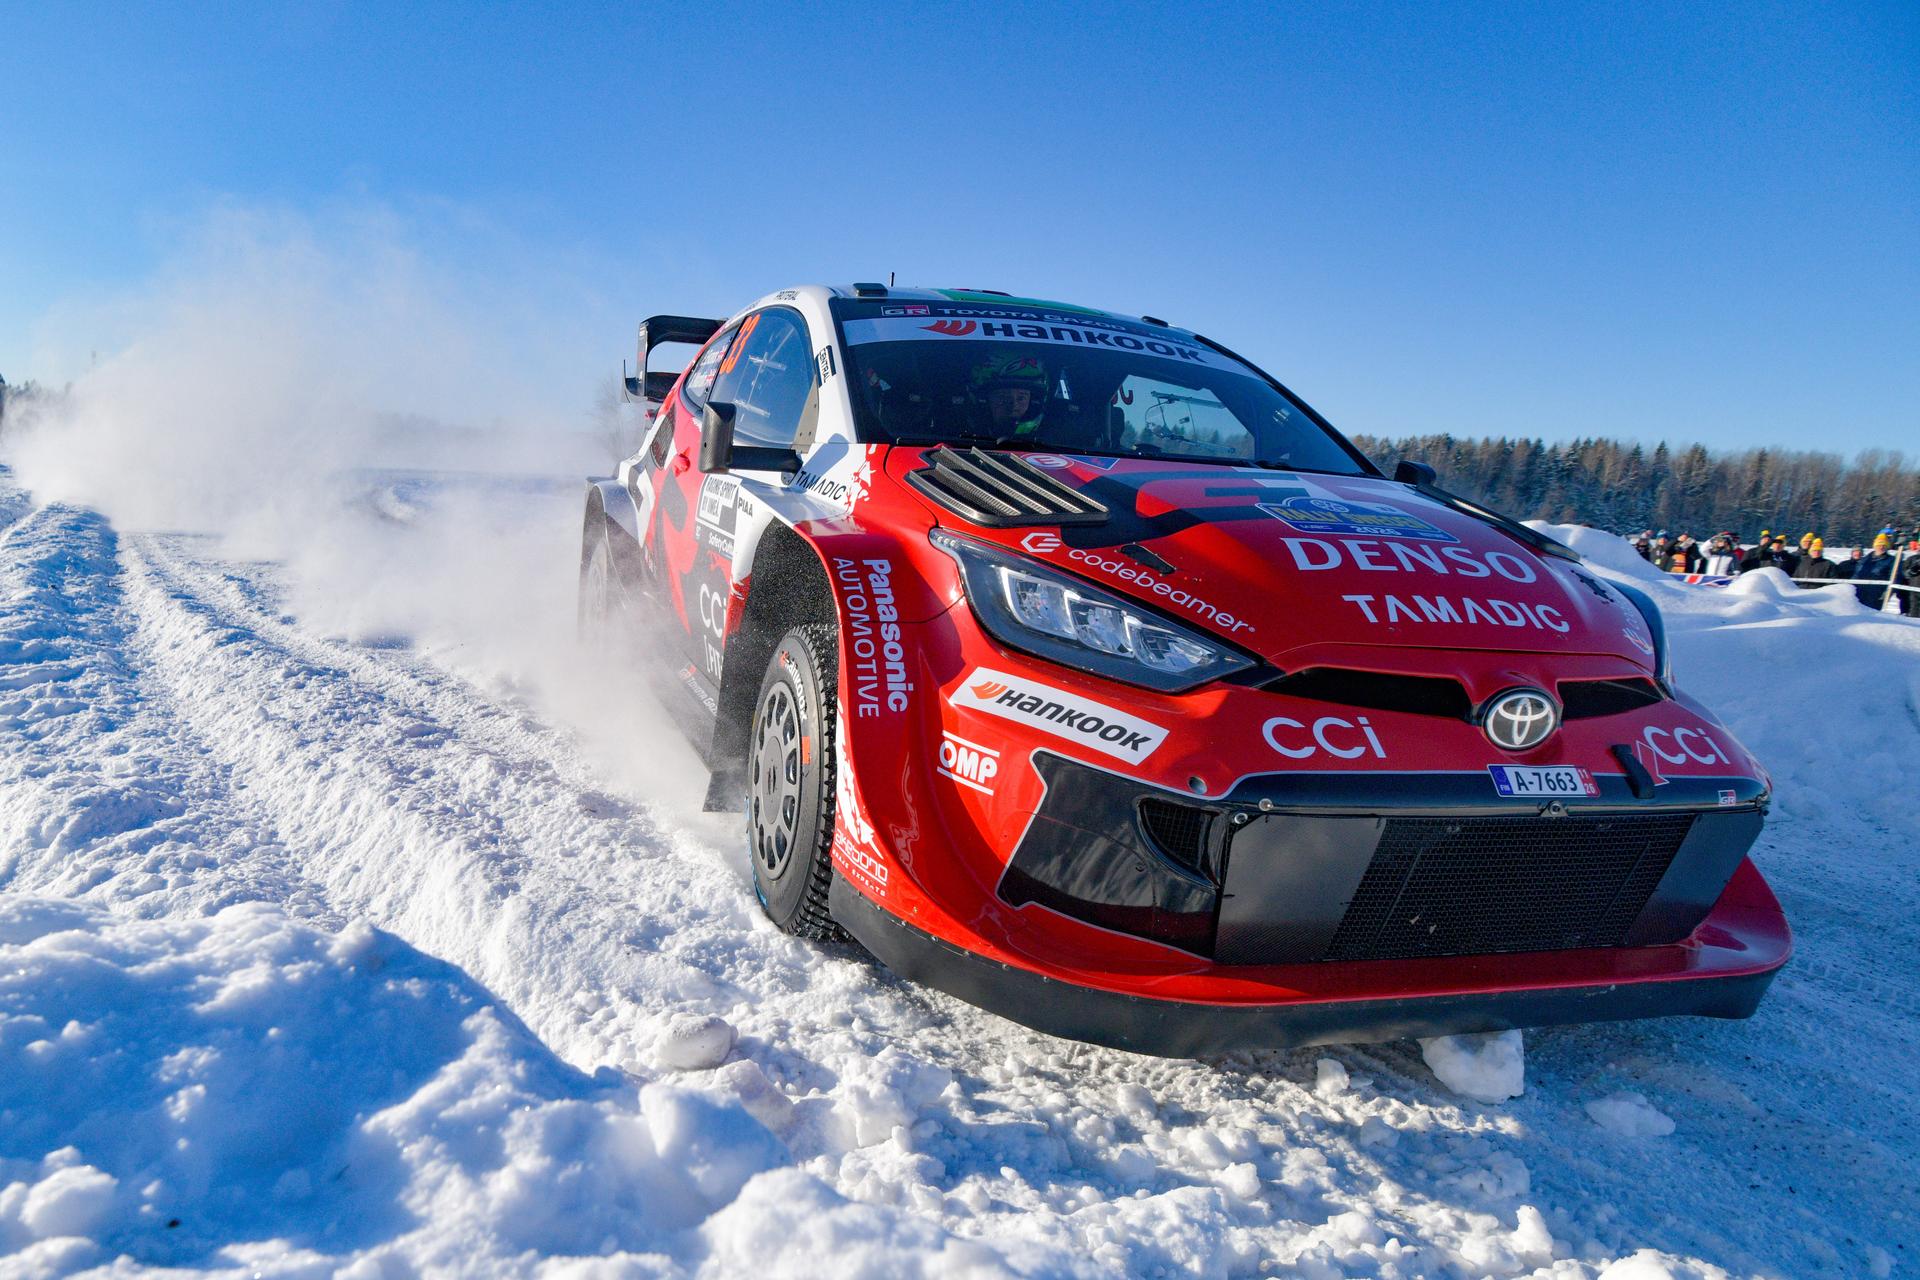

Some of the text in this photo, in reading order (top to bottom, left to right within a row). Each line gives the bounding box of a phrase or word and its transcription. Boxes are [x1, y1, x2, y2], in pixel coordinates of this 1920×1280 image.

[937, 307, 1035, 320] TOYOTA
[1043, 313, 1126, 331] GAZOO
[799, 471, 846, 500] TAMADIC
[738, 497, 754, 518] PIAA
[1280, 537, 1538, 584] DENSO
[700, 583, 727, 639] CCi
[1068, 548, 1250, 634] codebeamer
[1341, 594, 1570, 633] TAMADIC
[832, 557, 880, 718] AUTOMOTIVE
[862, 559, 914, 713] Panasonic
[1262, 716, 1387, 759] CCi
[1642, 725, 1730, 765] CCi
[939, 740, 998, 784] OMP
[1514, 770, 1578, 792] A-7663
[1577, 768, 1589, 779] 11
[1584, 783, 1596, 794] 26
